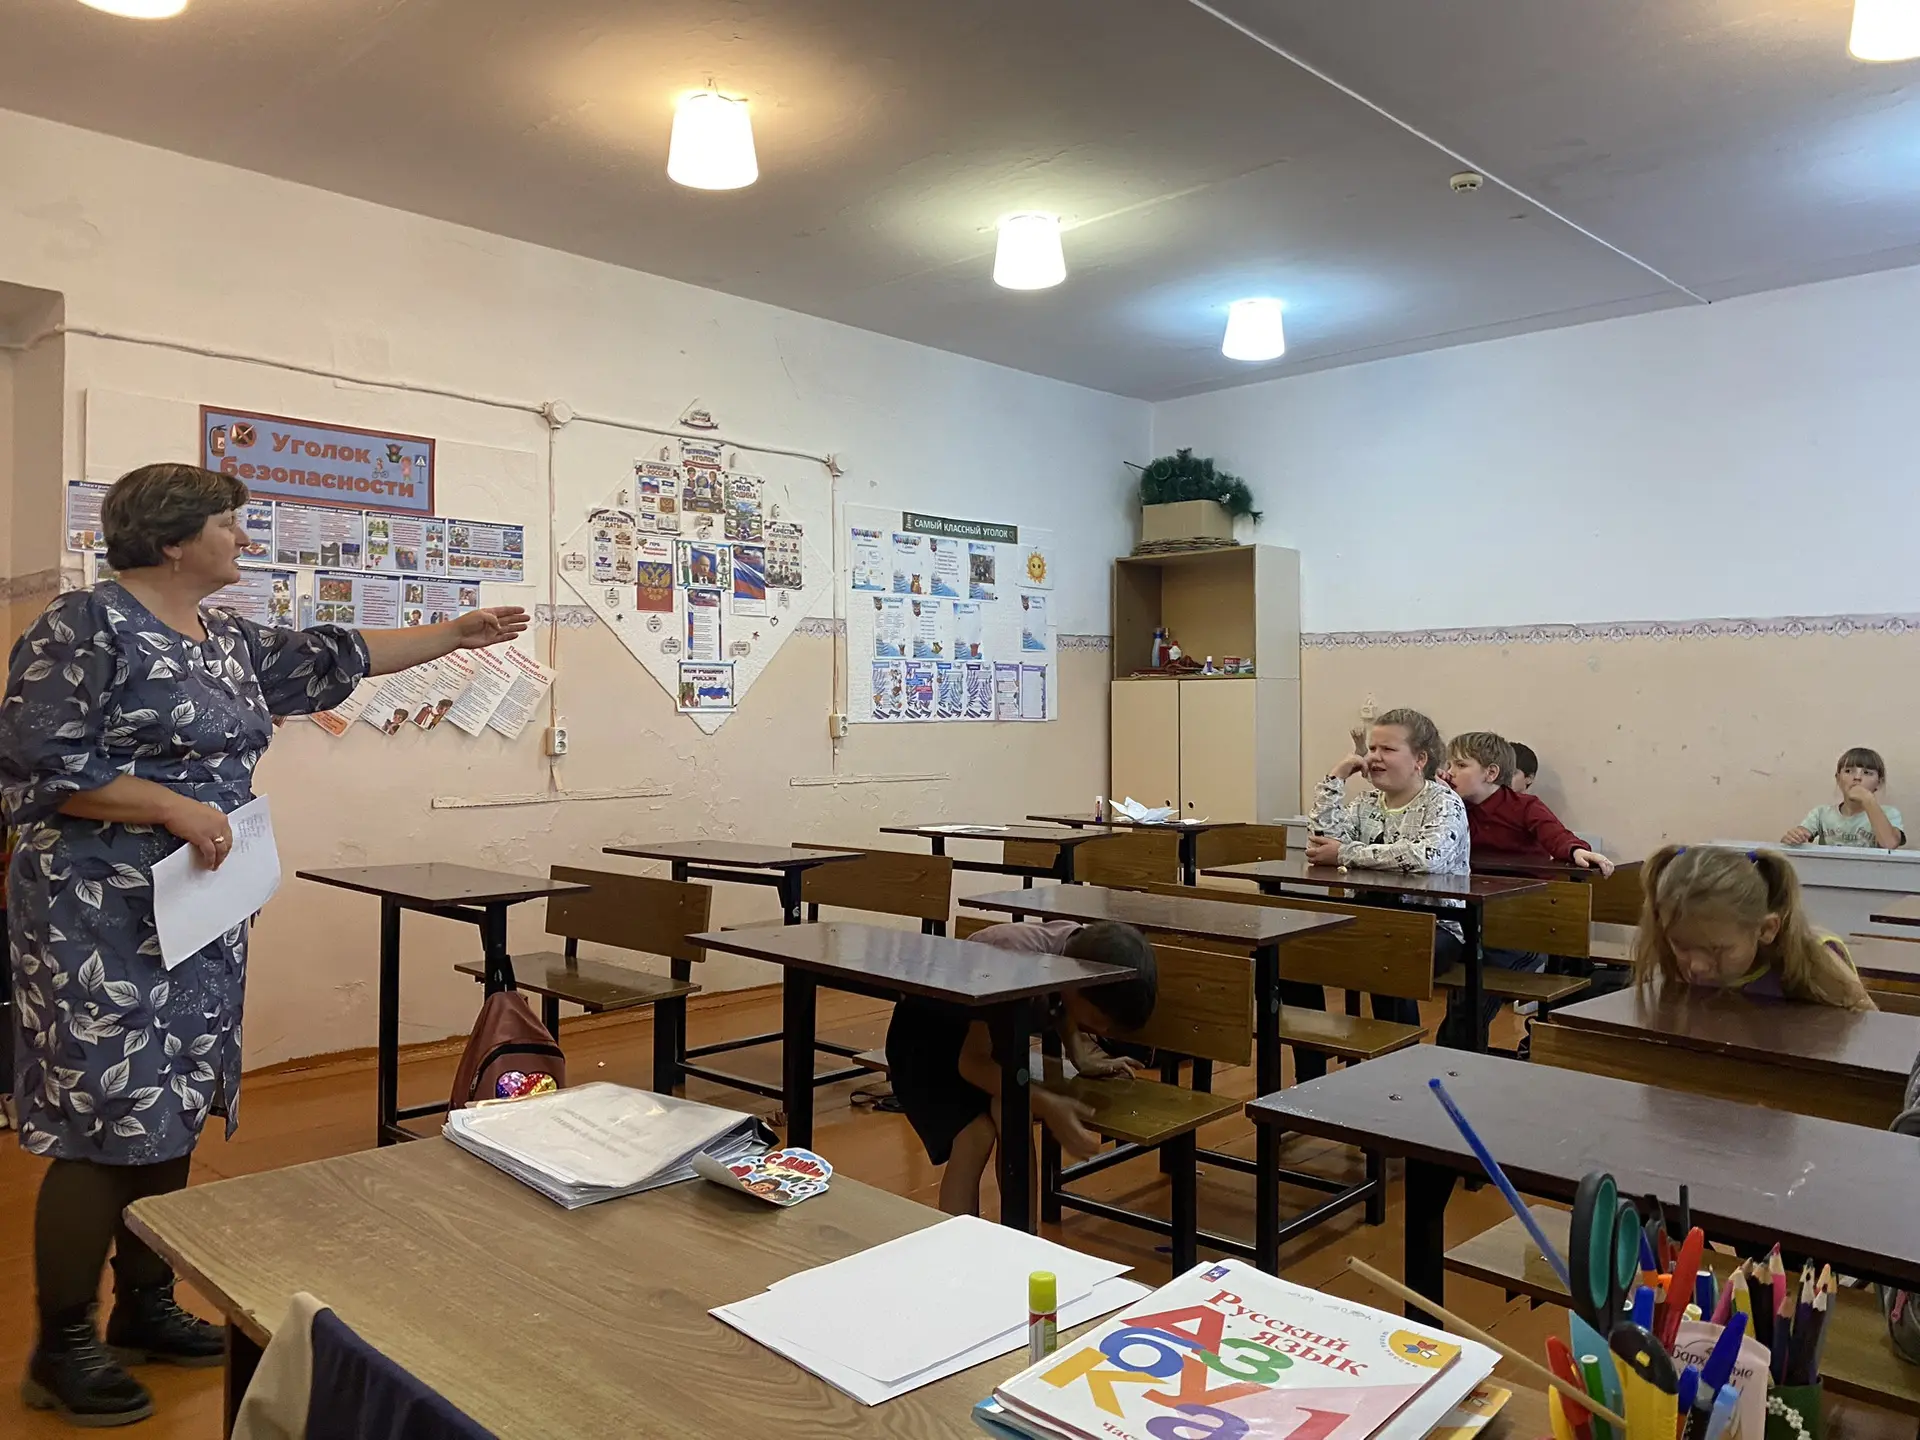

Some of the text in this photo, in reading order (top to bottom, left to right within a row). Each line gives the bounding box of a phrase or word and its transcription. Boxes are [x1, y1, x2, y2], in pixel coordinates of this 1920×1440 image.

[271, 432, 370, 464] Уголок
[219, 456, 414, 498] безопасности
[736, 484, 751, 492] МОЯ
[731, 491, 757, 500] РОДИНА
[597, 515, 629, 524] ПАМЯТНЫЕ
[914, 519, 1008, 538] САМЫЙ КЛАССНЫЙ УГОЛОК
[471, 649, 512, 679] езопасность
[480, 647, 503, 666] жарная
[504, 651, 549, 681] безопасность
[508, 645, 541, 670] Пожарная
[1204, 1288, 1351, 1353] Русский
